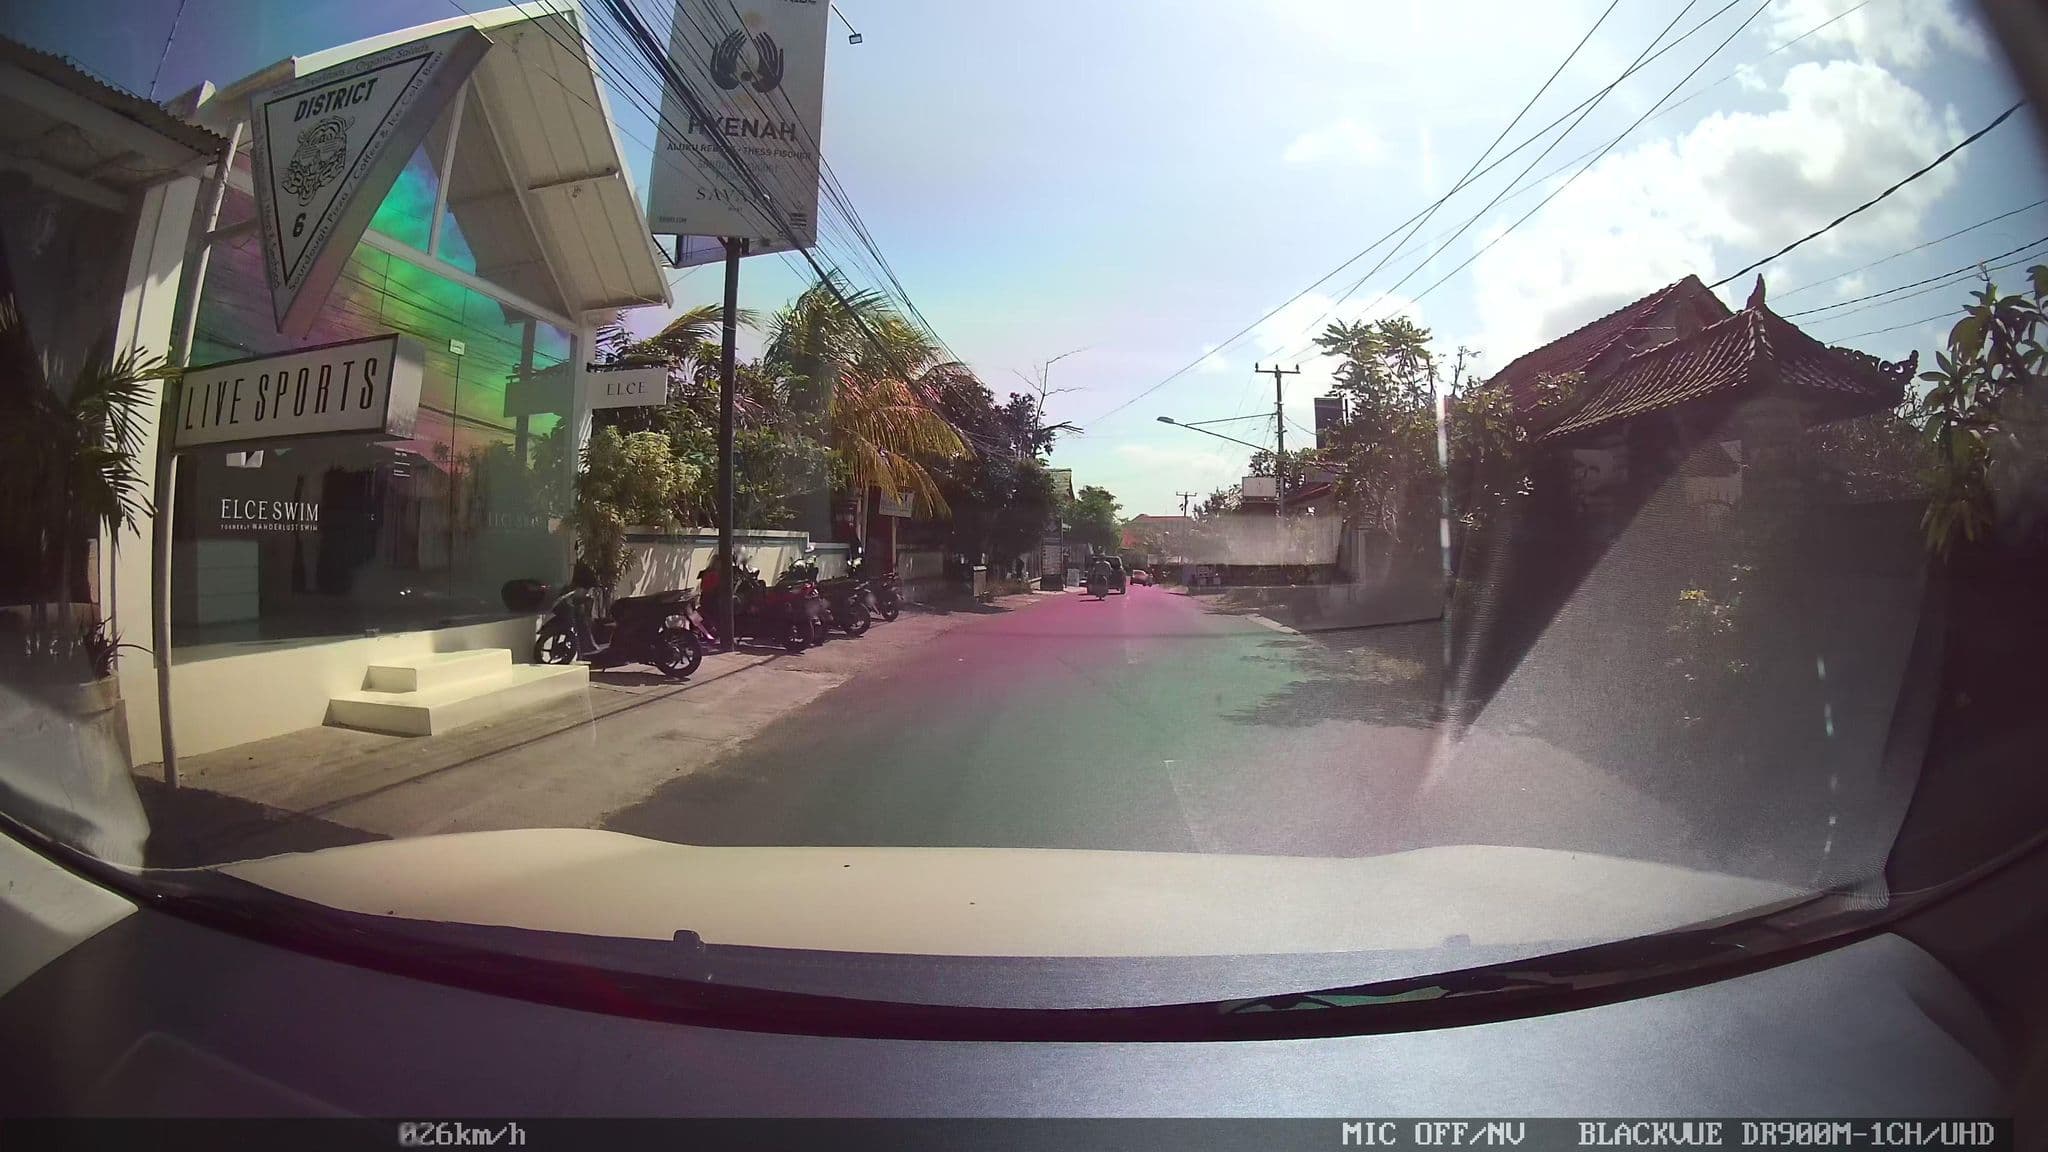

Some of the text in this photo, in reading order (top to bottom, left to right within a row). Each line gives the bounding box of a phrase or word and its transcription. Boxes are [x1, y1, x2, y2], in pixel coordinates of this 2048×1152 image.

[294, 77, 379, 122] DISTRICT
[288, 224, 329, 290] Sourdough
[327, 192, 349, 224] Pizza
[353, 140, 379, 180] Coffee
[292, 212, 307, 238] 6
[185, 357, 378, 430] LIVE SPORTS
[606, 381, 649, 396] ELCE
[220, 499, 319, 522] ELCE SWIM
[252, 523, 298, 532] WANDERLUST
[300, 523, 318, 532] SWIM
